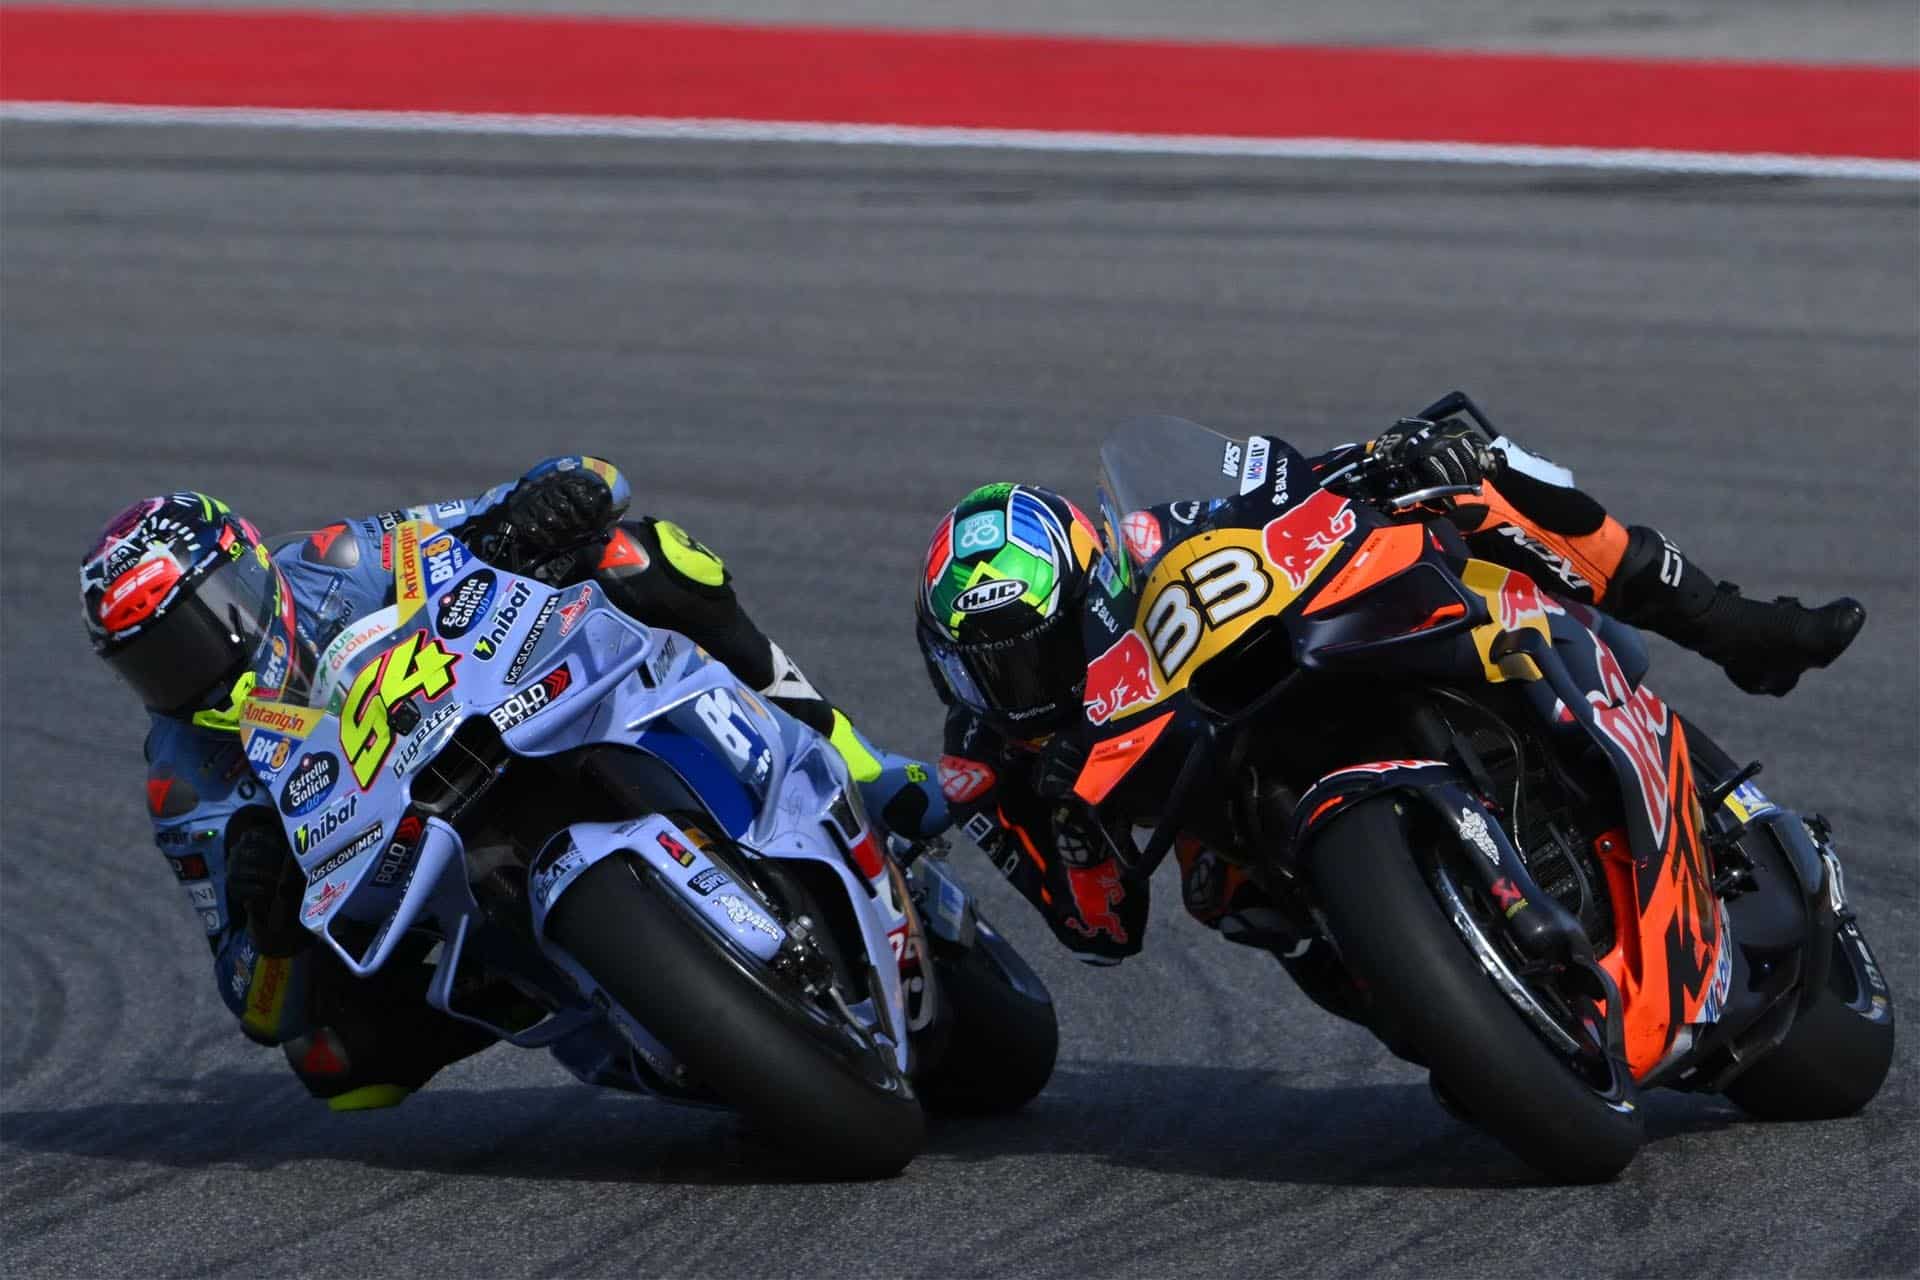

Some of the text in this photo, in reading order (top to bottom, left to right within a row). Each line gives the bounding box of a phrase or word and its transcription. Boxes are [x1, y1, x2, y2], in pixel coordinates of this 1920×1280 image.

[402, 526, 419, 600] Antangin
[423, 535, 455, 585] BK8
[441, 578, 478, 627] Estrella
[455, 581, 489, 629] Galicia
[962, 581, 1018, 609] HJC
[1142, 546, 1274, 684] 33
[472, 581, 532, 662] Unibat
[330, 624, 389, 671] GLOBAL
[244, 702, 304, 732] Antangin
[336, 629, 467, 792] 54
[490, 683, 546, 728] BOLD
[248, 736, 290, 773] BK8
[288, 759, 330, 795] Estrella
[291, 774, 331, 808] Galicia
[294, 794, 358, 856] Unibat
[376, 842, 406, 884] BOLD
